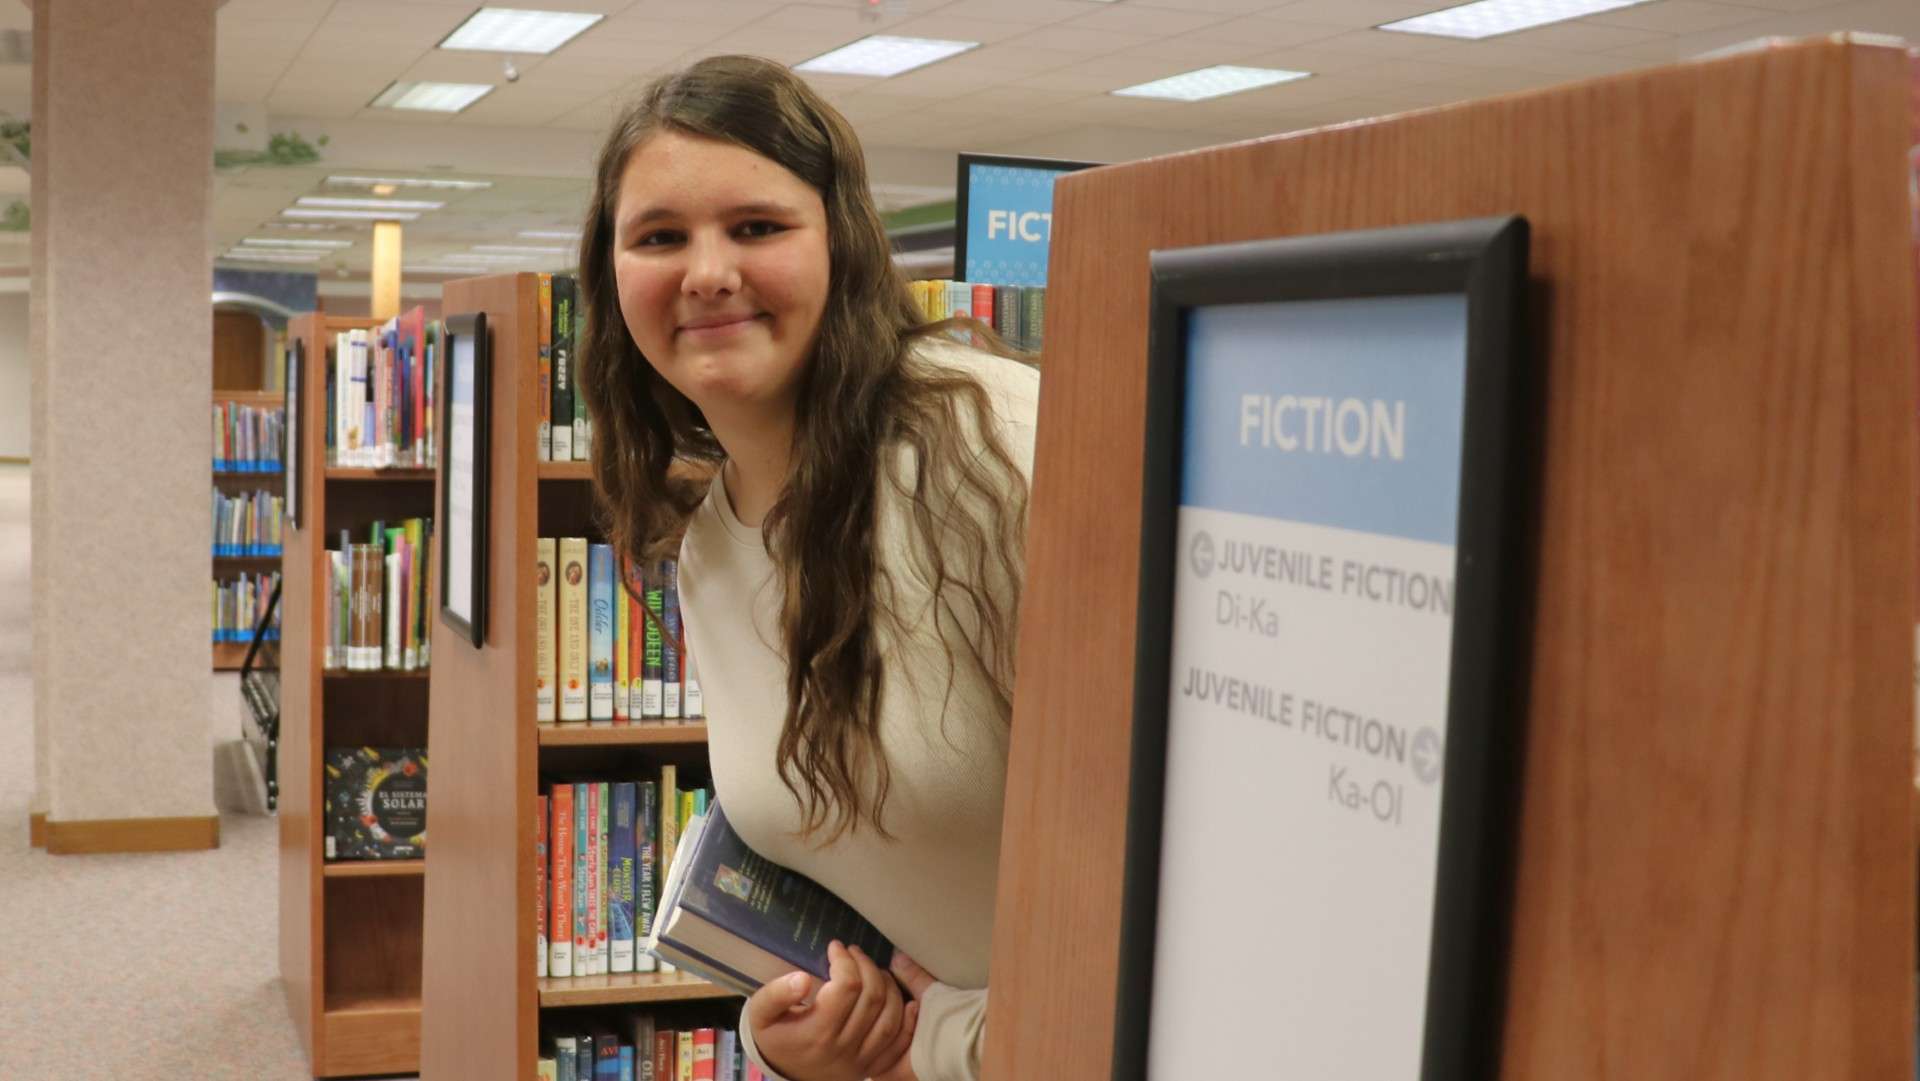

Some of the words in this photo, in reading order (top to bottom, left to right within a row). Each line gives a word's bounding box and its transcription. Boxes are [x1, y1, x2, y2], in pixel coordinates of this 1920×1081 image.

[1239, 392, 1406, 462] FICTION
[1217, 539, 1333, 591] JUVENILE
[1341, 560, 1452, 615] FICTION
[593, 598, 609, 635] Odder
[1216, 590, 1279, 638] Di-Ka
[1184, 667, 1293, 727] JUVENILE
[1300, 700, 1406, 764] FICTION
[383, 799, 425, 809] SOLAR
[558, 827, 568, 856] House
[641, 846, 652, 861] THE
[558, 858, 568, 879] That
[641, 862, 652, 882] YEAR
[641, 889, 652, 910] FLEW
[641, 911, 652, 935] AWAY
[641, 1059, 653, 1081] OL
